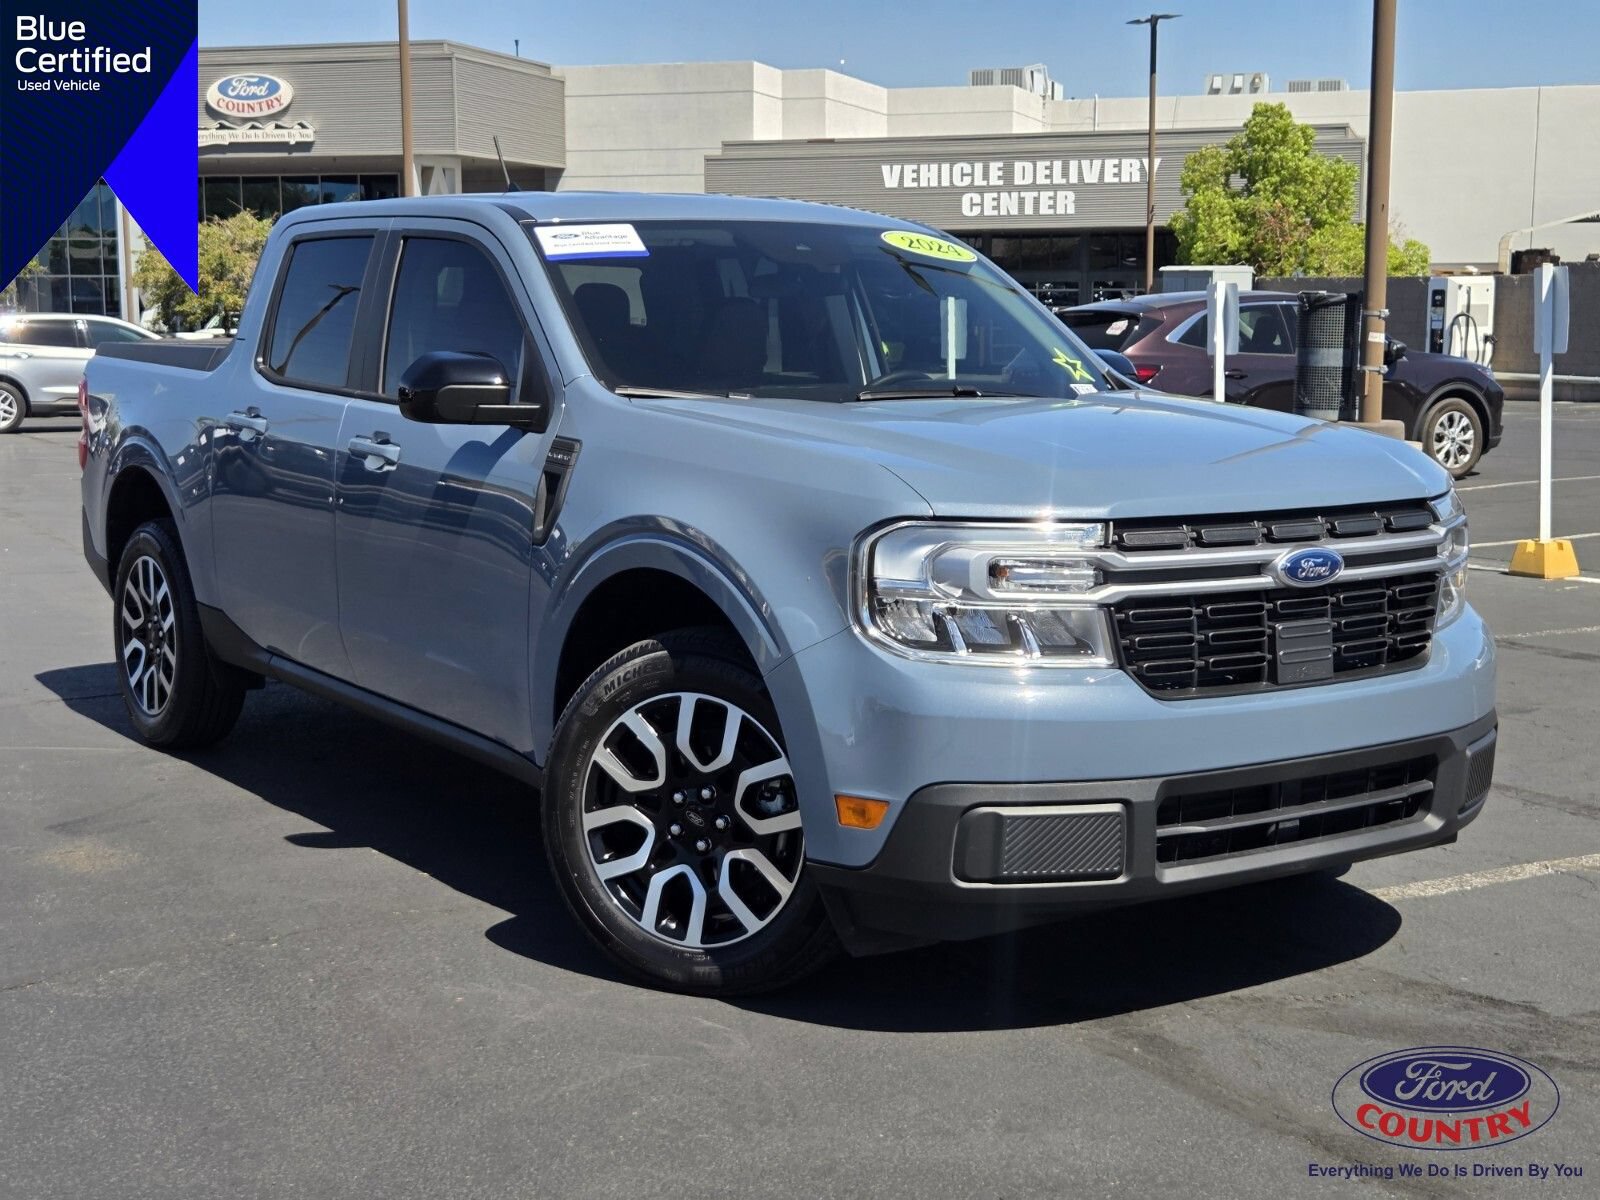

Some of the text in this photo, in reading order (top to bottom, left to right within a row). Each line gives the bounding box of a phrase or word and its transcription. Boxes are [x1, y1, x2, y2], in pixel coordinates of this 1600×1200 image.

[228, 76, 270, 97] Ford
[216, 96, 284, 114] COUNTRY
[198, 131, 312, 142] erything We Do Is Driven By You
[881, 157, 1162, 189] VEHICLE DELIVERY
[961, 190, 1076, 217] CENTER
[901, 235, 962, 257] 2024
[1297, 557, 1331, 579] Ford
